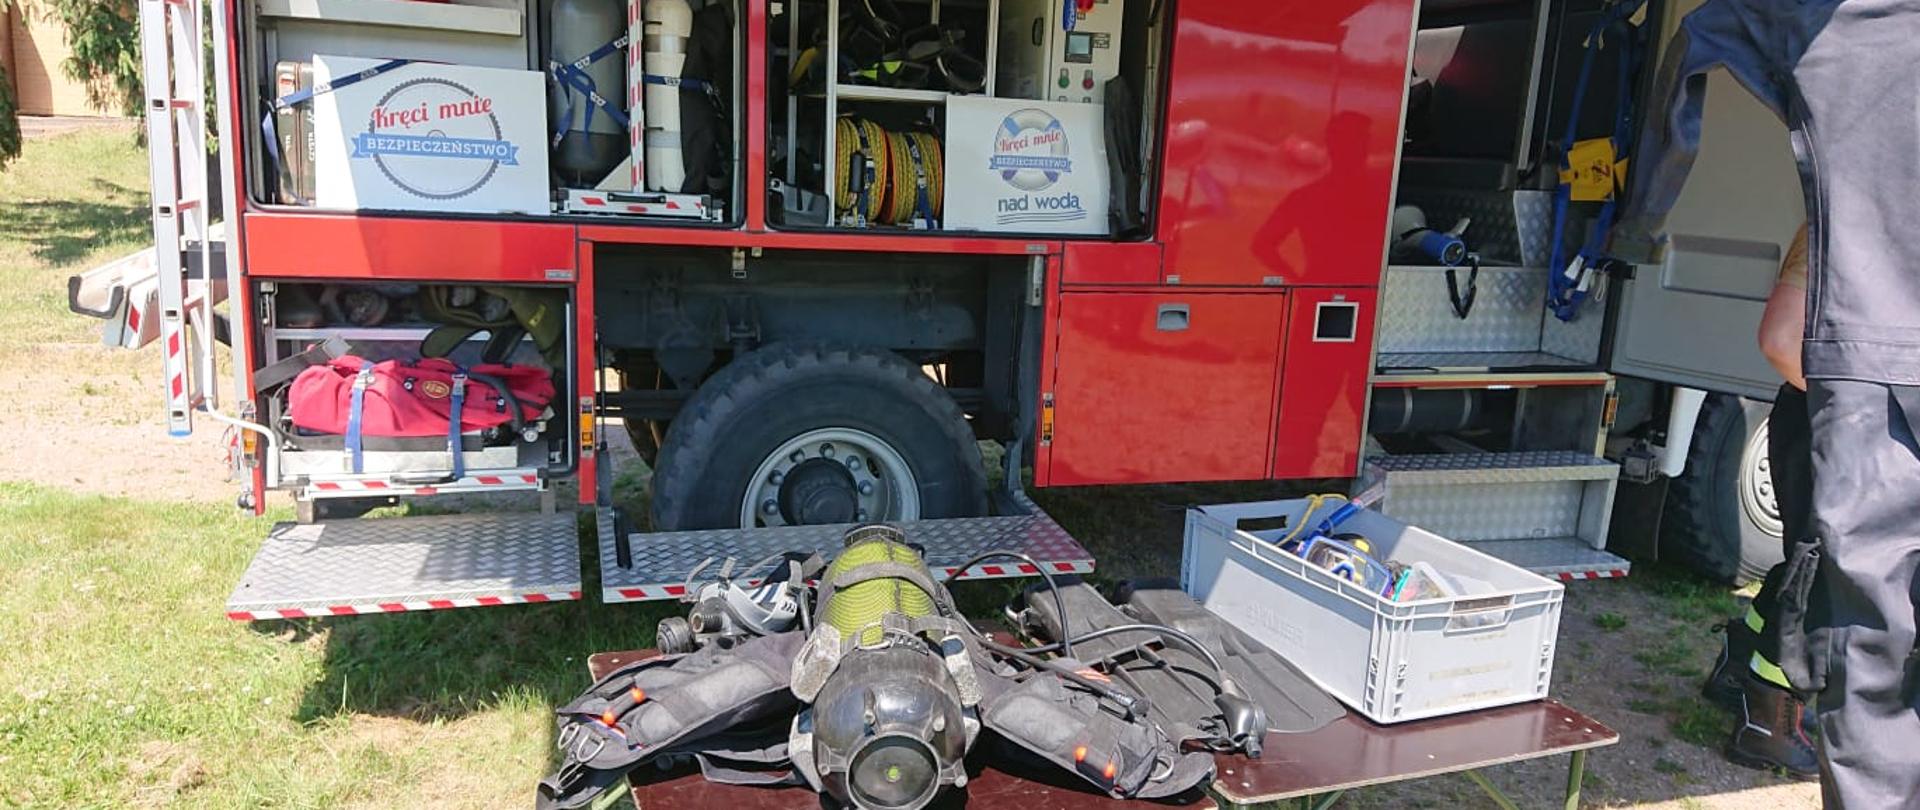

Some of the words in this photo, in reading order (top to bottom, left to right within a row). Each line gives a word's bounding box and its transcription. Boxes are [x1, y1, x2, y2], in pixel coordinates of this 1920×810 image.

[371, 102, 430, 129] Kręci
[439, 95, 492, 119] mnie
[367, 137, 508, 157] BEZPIECZEŃSTWO
[998, 194, 1028, 212] nad
[1034, 192, 1082, 209] wodą
